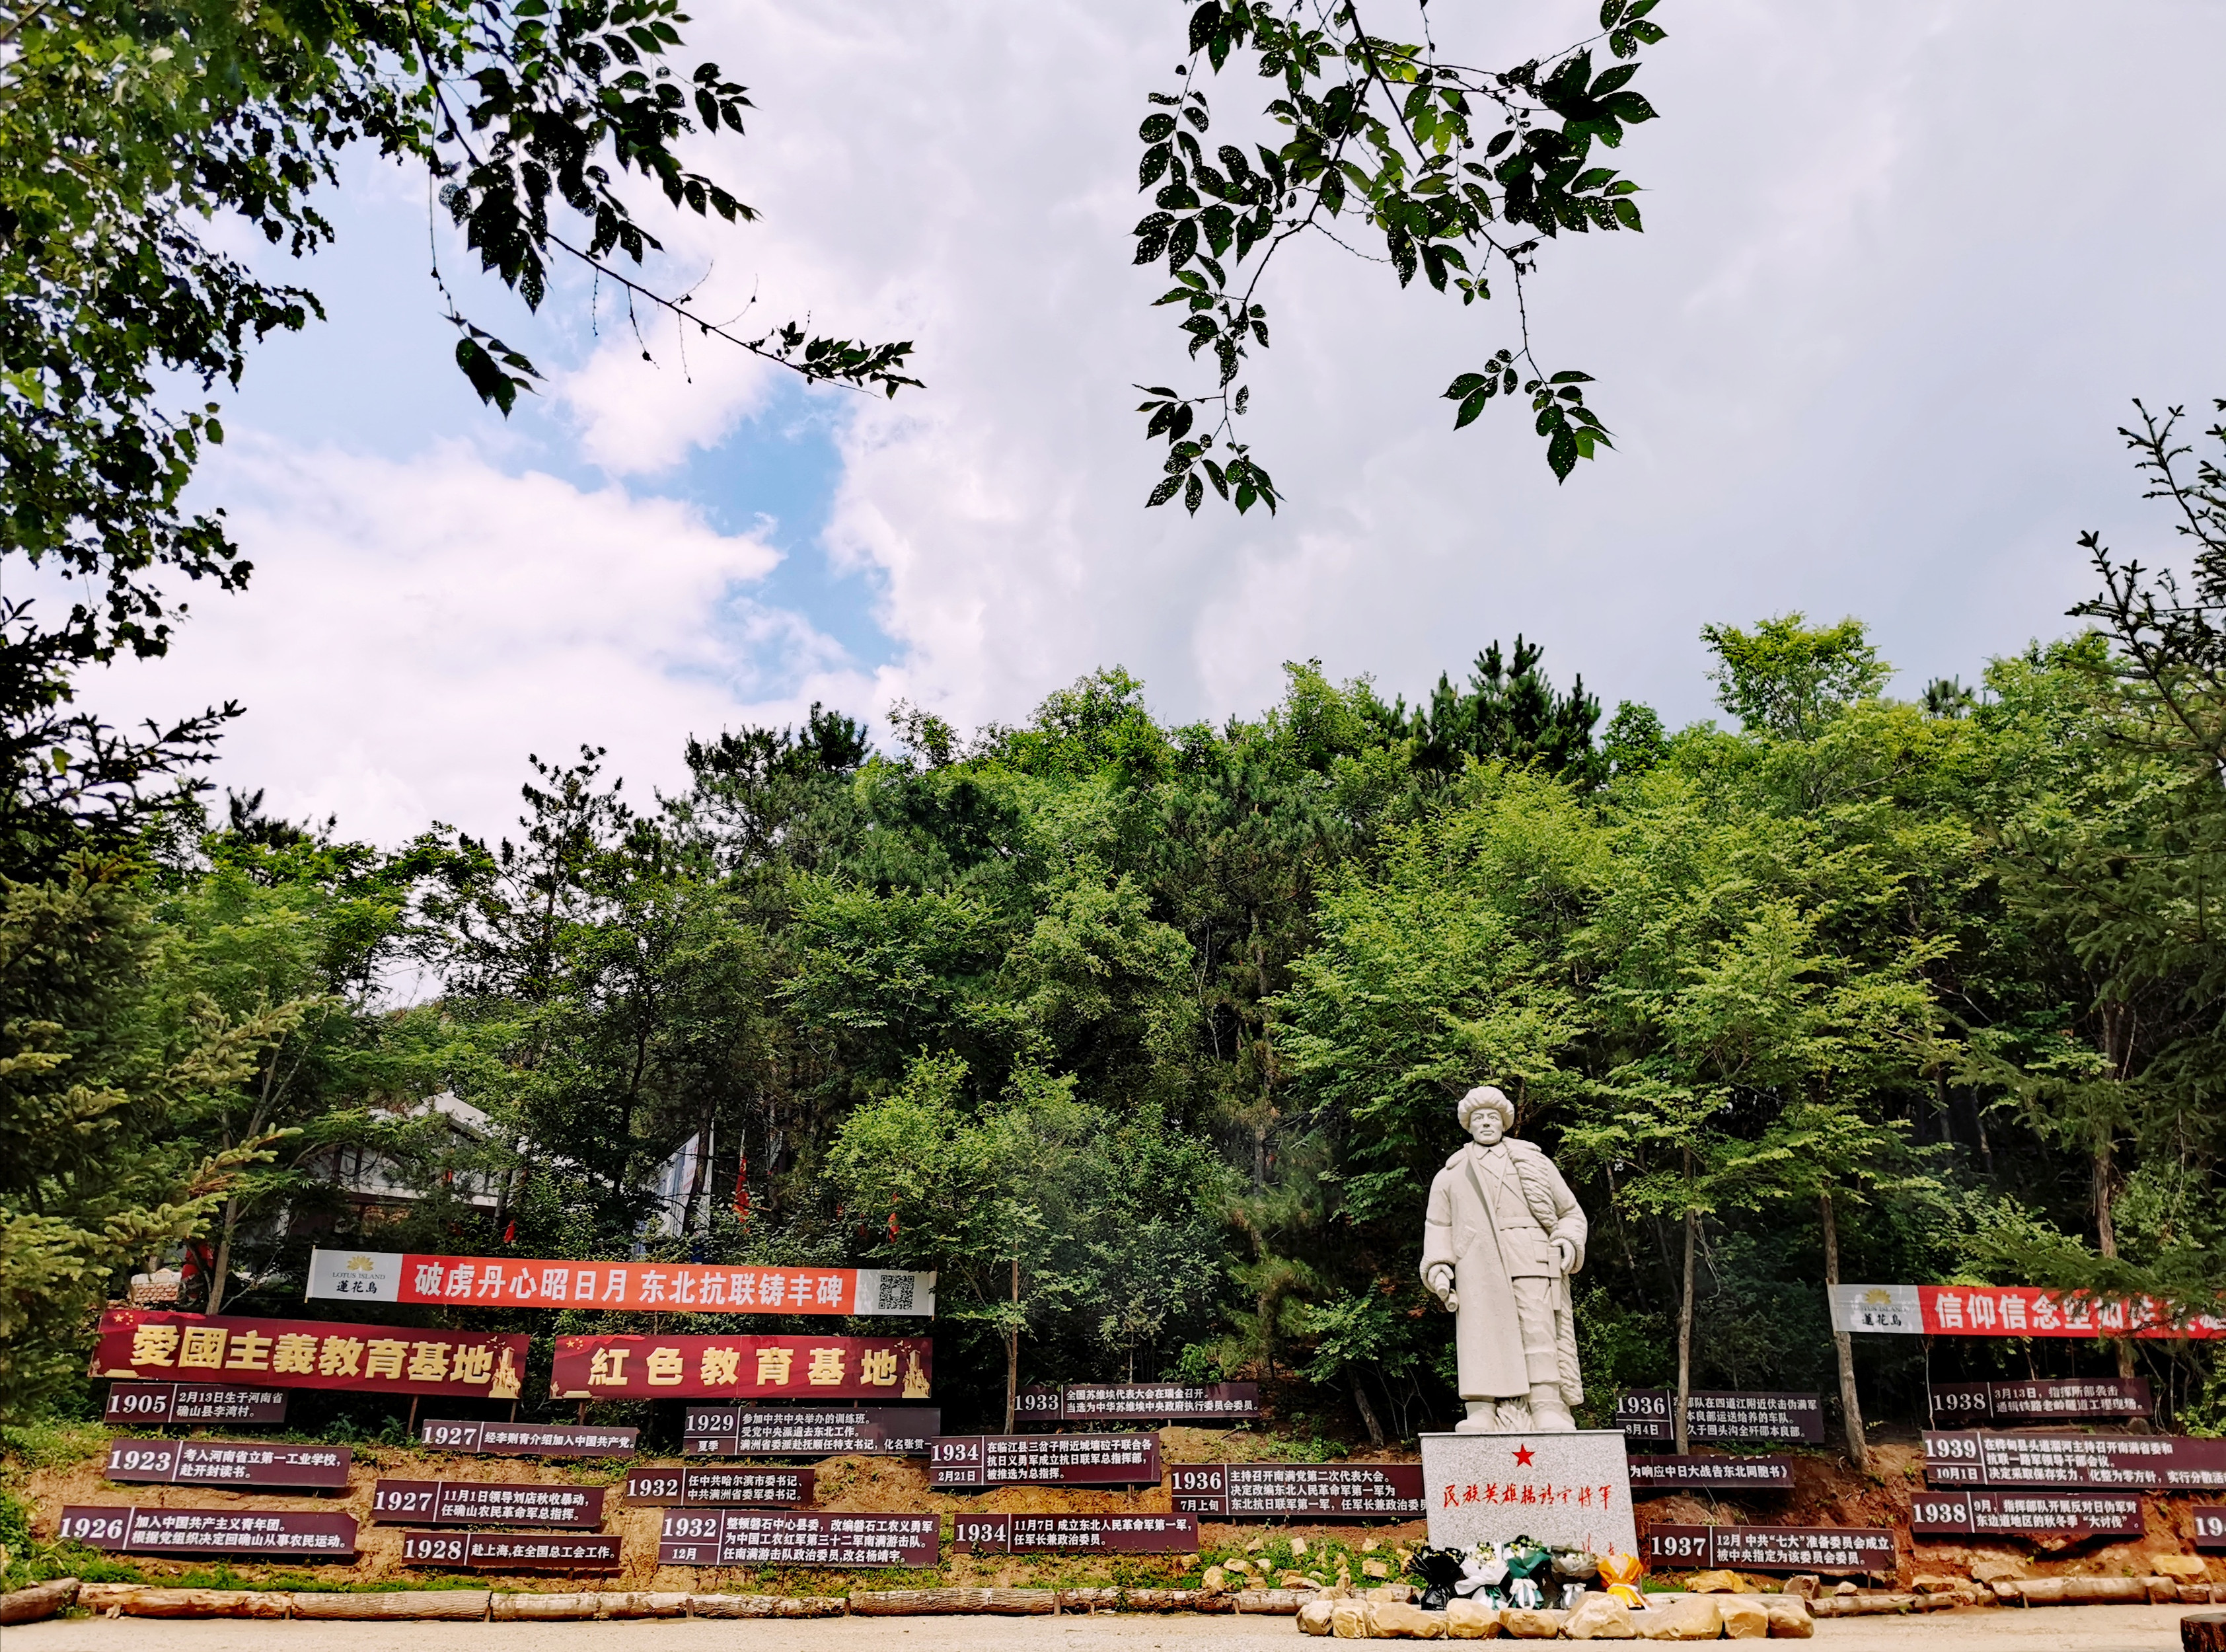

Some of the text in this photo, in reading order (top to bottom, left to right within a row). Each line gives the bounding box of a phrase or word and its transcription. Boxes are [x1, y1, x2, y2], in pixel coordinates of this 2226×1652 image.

[336, 1281, 377, 1295] 蓮花島
[414, 1261, 844, 1308] 破虏丹心昭日月 东北抗联铸丰碑
[130, 1324, 494, 1384] 愛國主義教育基地
[588, 1346, 898, 1386] 紅色教育基地
[108, 1394, 167, 1414] 1905
[178, 1391, 284, 1405] 2月13日生于河南省
[1014, 1394, 1058, 1411] 1933
[1616, 1396, 1665, 1415] 1936
[1933, 1392, 1986, 1411] 1938
[176, 1405, 255, 1418] 确山县李湾村。
[1674, 1410, 1795, 1425] 本良部运送给养的车队。
[685, 1412, 735, 1433] 1929
[1625, 1423, 1659, 1436] 8月4日
[421, 1425, 478, 1445] 1927
[484, 1430, 636, 1450] 经李则青介绍加入中国共产党。
[697, 1440, 719, 1452] 夏季
[931, 1443, 979, 1462] 1934
[1924, 1438, 1976, 1459] 1939
[107, 1449, 172, 1472] 1923
[179, 1463, 252, 1479] 赴开封读书。
[938, 1470, 976, 1482] 2月21日
[986, 1467, 1065, 1480] 被推选为总指挥。
[1936, 1467, 1978, 1481] 10月1日
[626, 1478, 679, 1498] 1932
[1171, 1471, 1222, 1491] 1936
[1230, 1483, 1396, 1497] 决定改编东北人民革命军第一军为
[373, 1491, 433, 1513] 1927
[686, 1489, 802, 1501] 中共满洲省委军委书记。
[441, 1505, 580, 1521] 任确山农民革命军总指挥。
[1180, 1499, 1219, 1512] 7月上旬
[1912, 1503, 1967, 1524] 1938
[59, 1517, 124, 1540] 1926
[134, 1515, 286, 1532] 加入中国共产主义青年团。
[661, 1517, 718, 1538] 1932
[955, 1522, 1007, 1543] 1934
[1014, 1520, 1055, 1532] 11月7日
[2195, 1516, 2226, 1537] 19
[131, 1530, 346, 1549] 根据党组织决定回确山从事农民运动。
[402, 1538, 463, 1560] 1928
[1013, 1533, 1107, 1547] 任军长兼政治委员。
[1651, 1536, 1706, 1557] 1937
[1716, 1534, 1741, 1548] 12月
[672, 1547, 698, 1561] 12月
